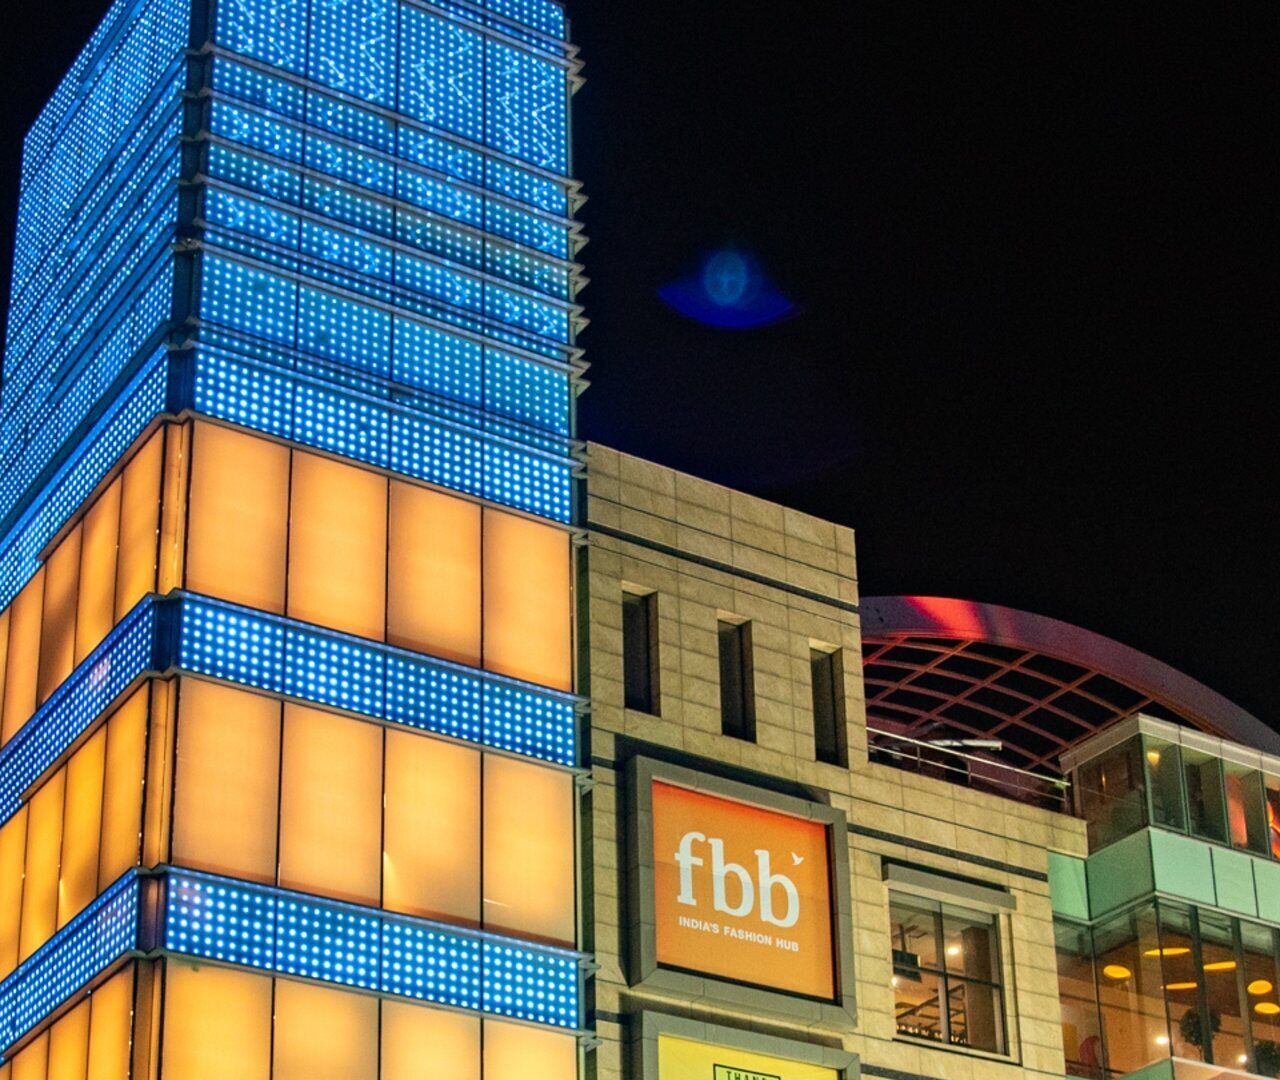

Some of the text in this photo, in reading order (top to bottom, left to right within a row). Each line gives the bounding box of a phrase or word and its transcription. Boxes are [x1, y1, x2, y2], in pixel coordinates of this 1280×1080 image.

[674, 831, 800, 928] fbb
[678, 915, 799, 952] INDIA'S FASHION HUB
